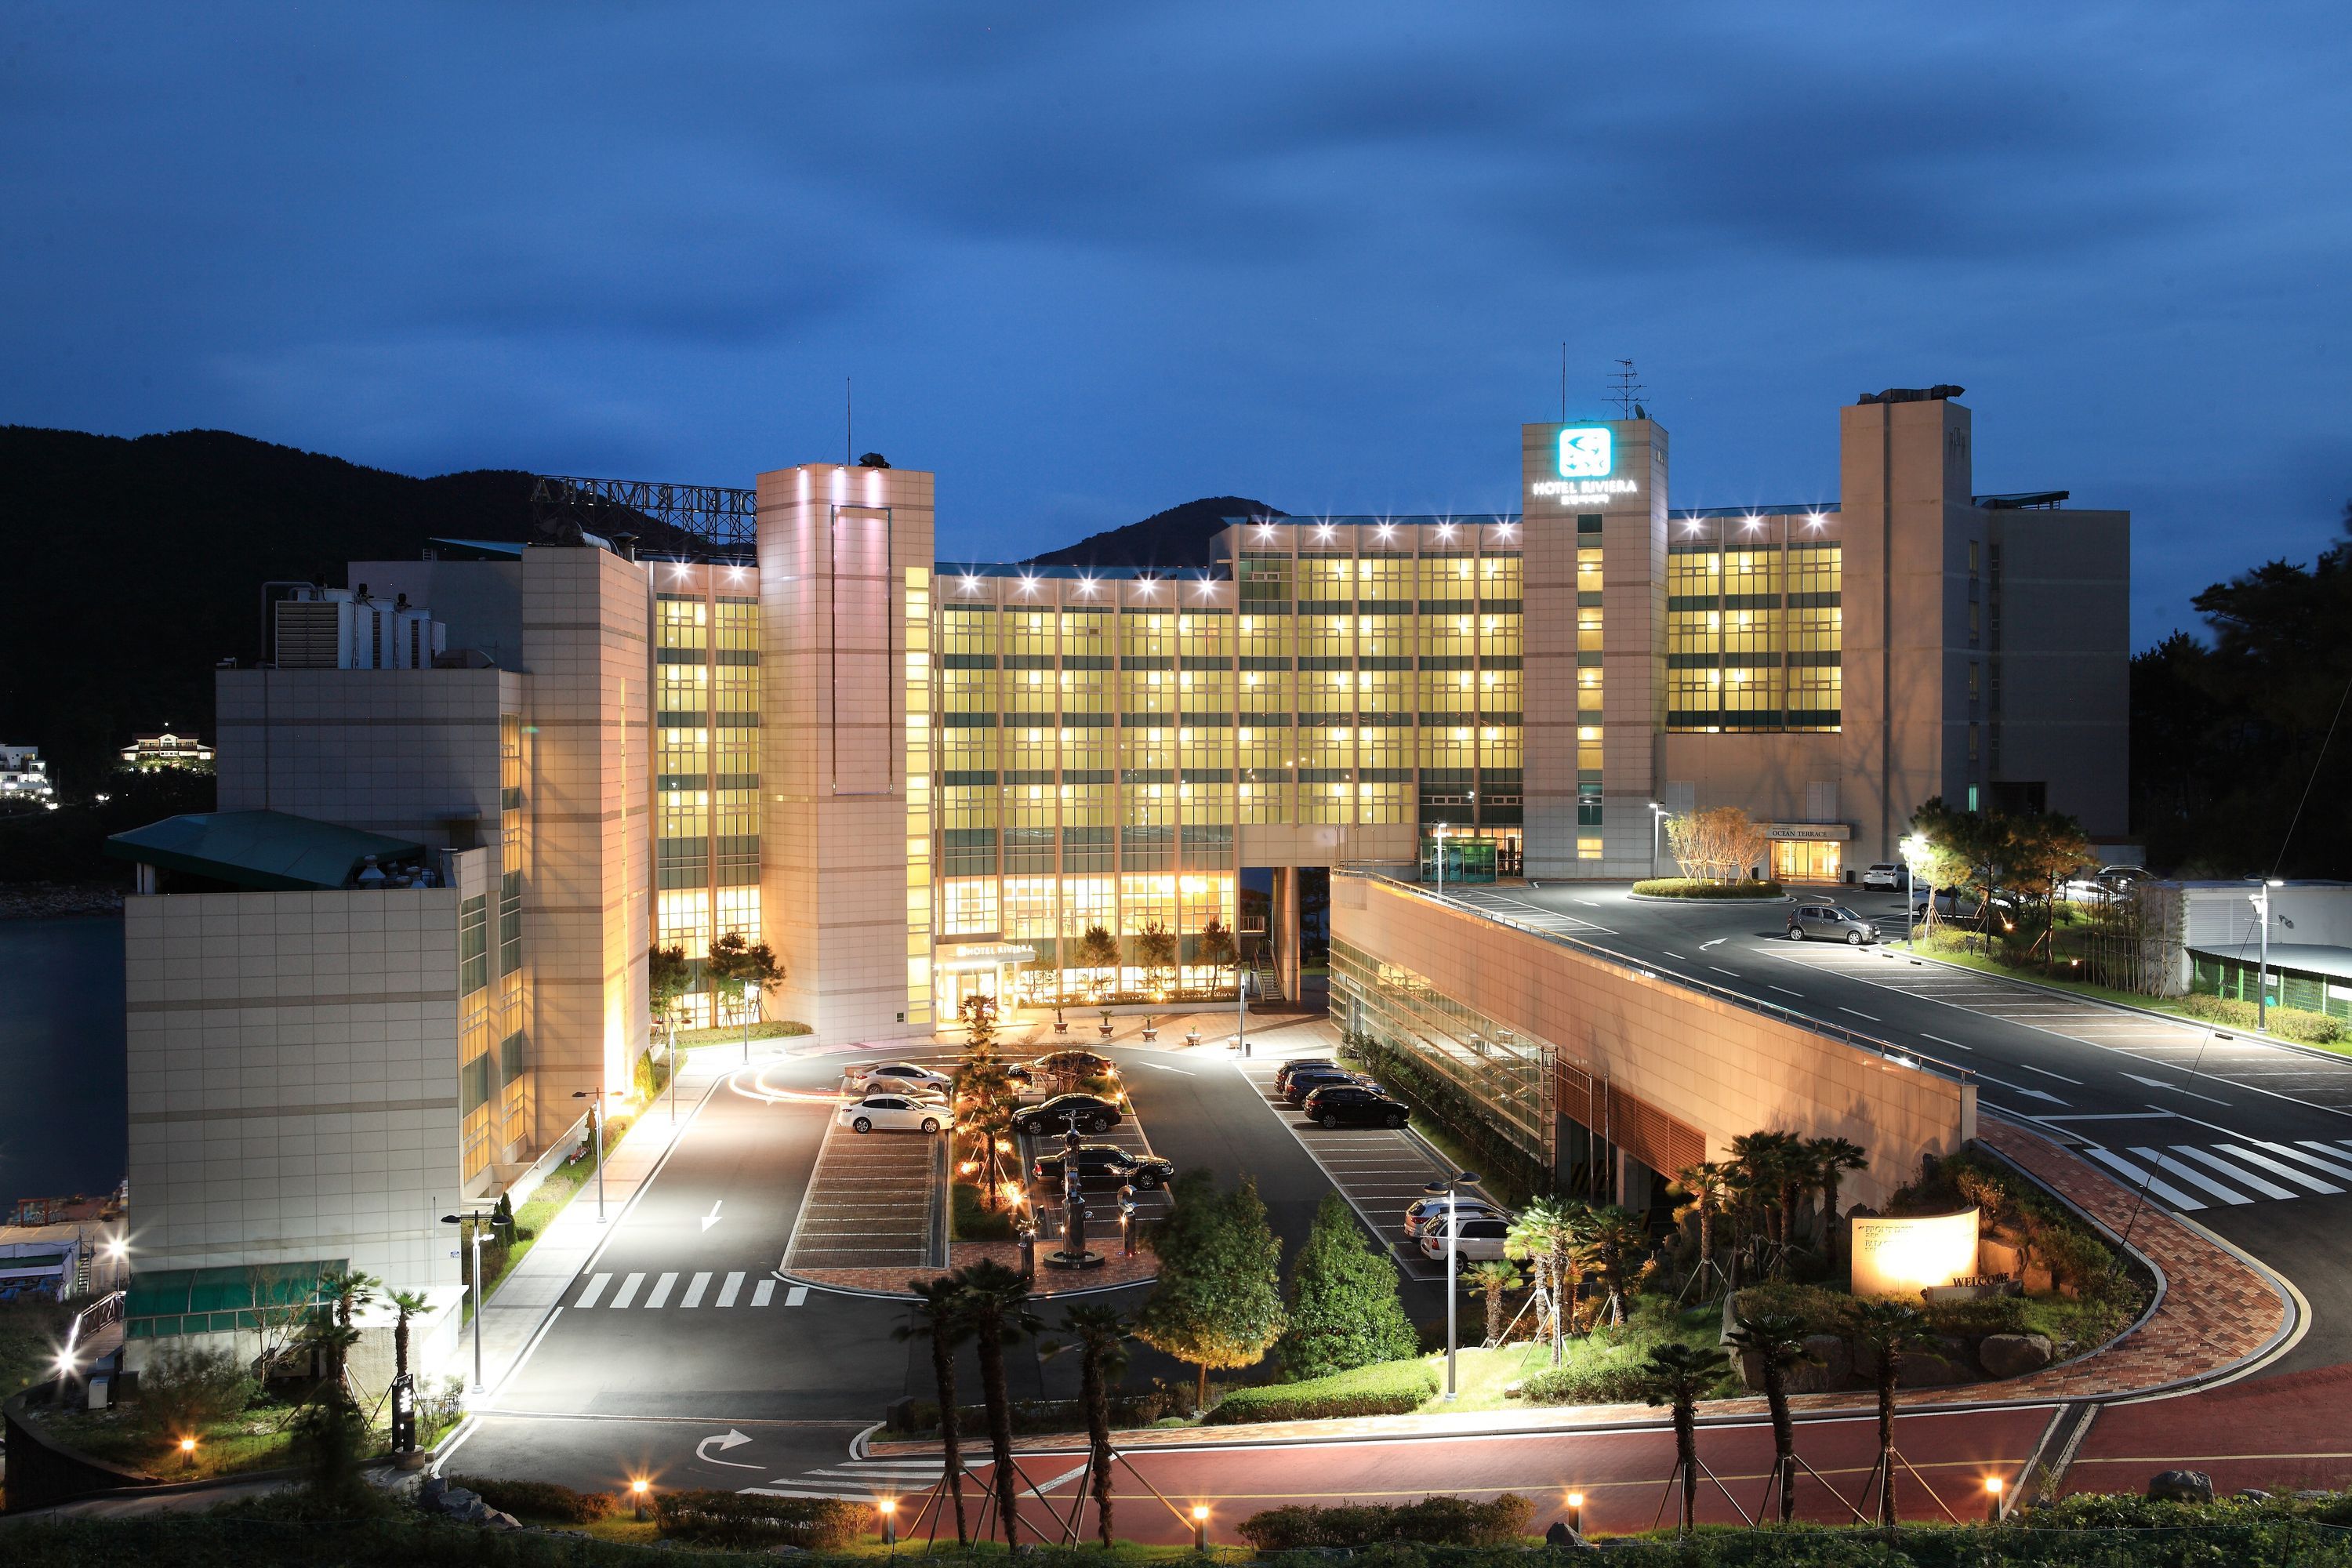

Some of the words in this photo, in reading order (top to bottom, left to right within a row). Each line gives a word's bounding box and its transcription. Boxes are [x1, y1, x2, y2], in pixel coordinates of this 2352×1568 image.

[1533, 481, 1577, 495] HOTEL
[1581, 480, 1638, 493] RIVIERA
[965, 946, 996, 956] HOTEL
[997, 944, 1035, 954] RIVIERA
[1952, 1272, 2010, 1287] WELCOME
